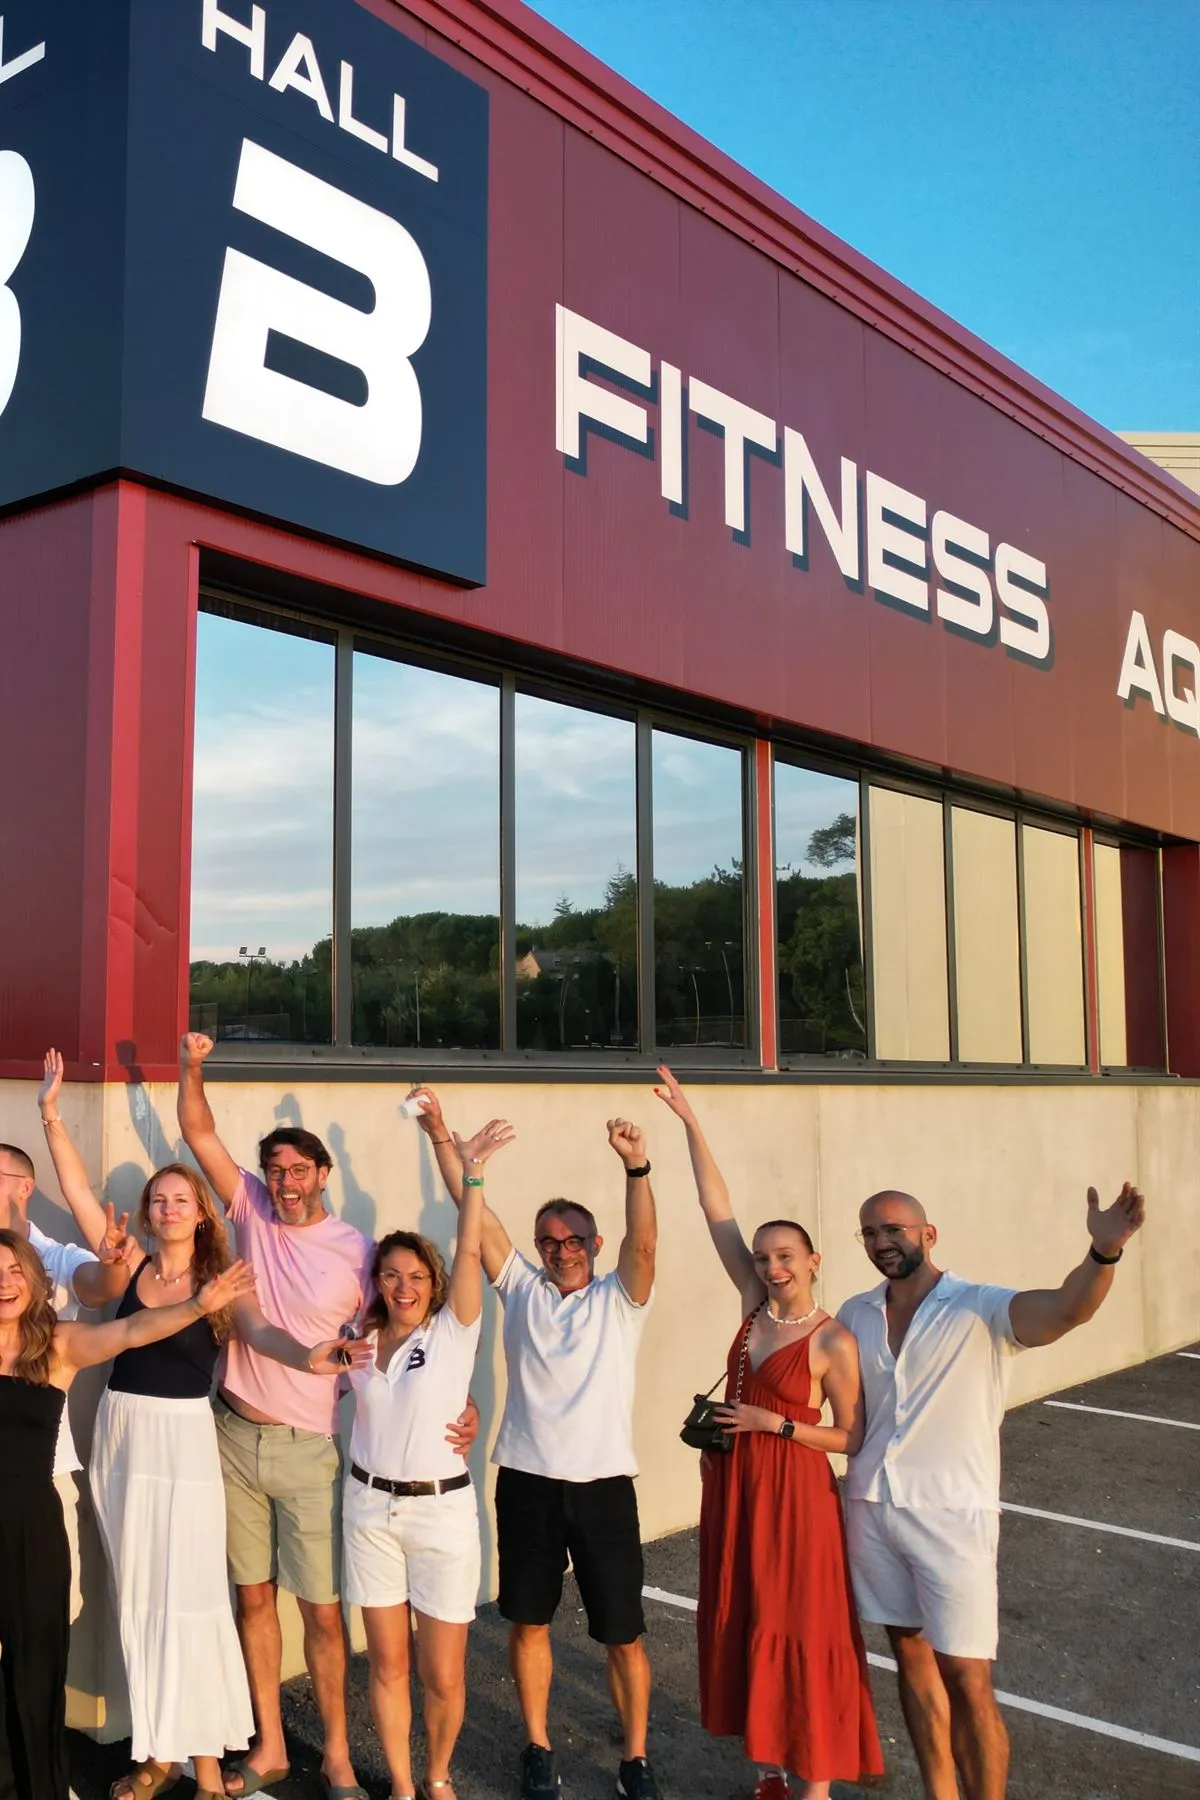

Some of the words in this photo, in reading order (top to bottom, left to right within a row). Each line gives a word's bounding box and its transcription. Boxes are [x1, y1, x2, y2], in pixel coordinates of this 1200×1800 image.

[202, 0, 439, 182] HALL
[202, 137, 432, 486] B
[555, 302, 1053, 662] FITNESS
[1116, 609, 1200, 741] AQ
